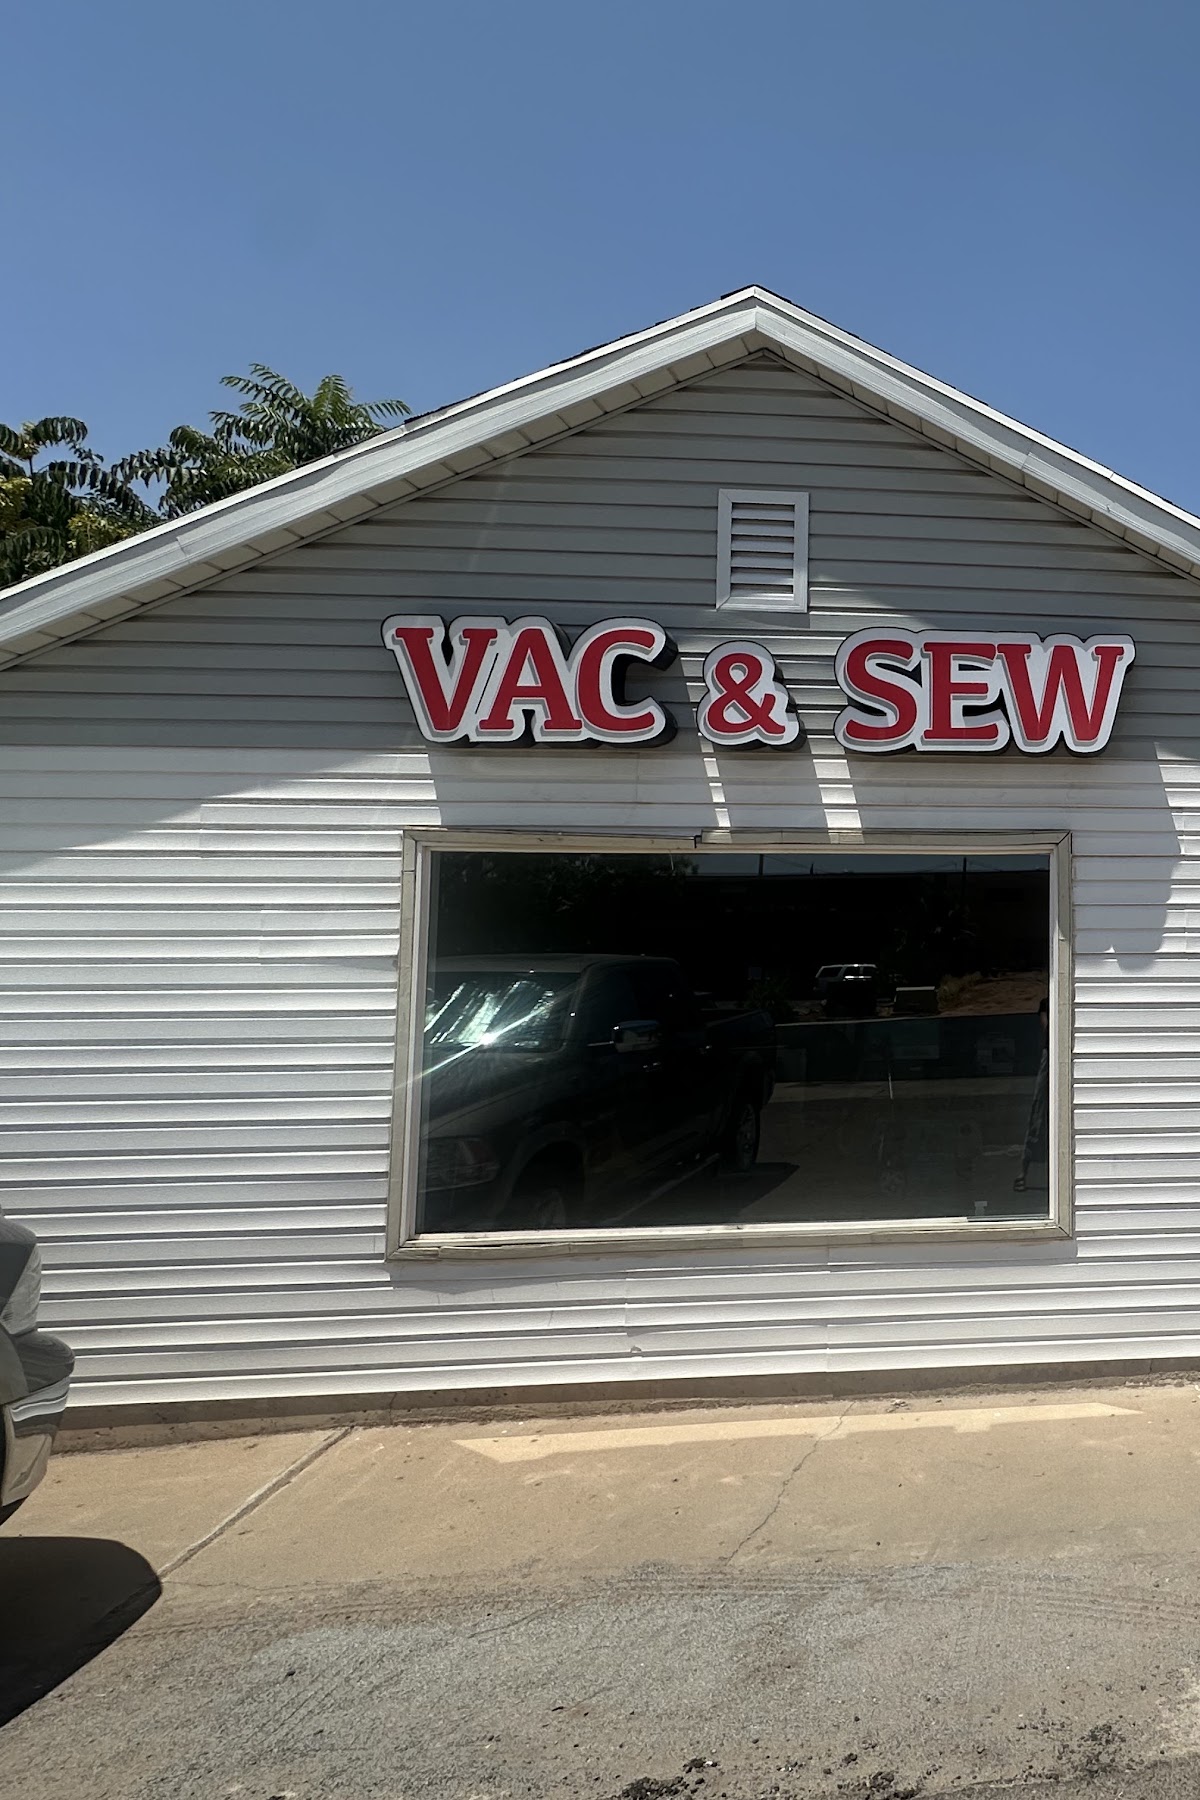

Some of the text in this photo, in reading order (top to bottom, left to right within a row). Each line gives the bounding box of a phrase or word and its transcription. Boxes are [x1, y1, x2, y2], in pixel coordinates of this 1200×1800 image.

[388, 620, 1129, 747] VAC & SEW
